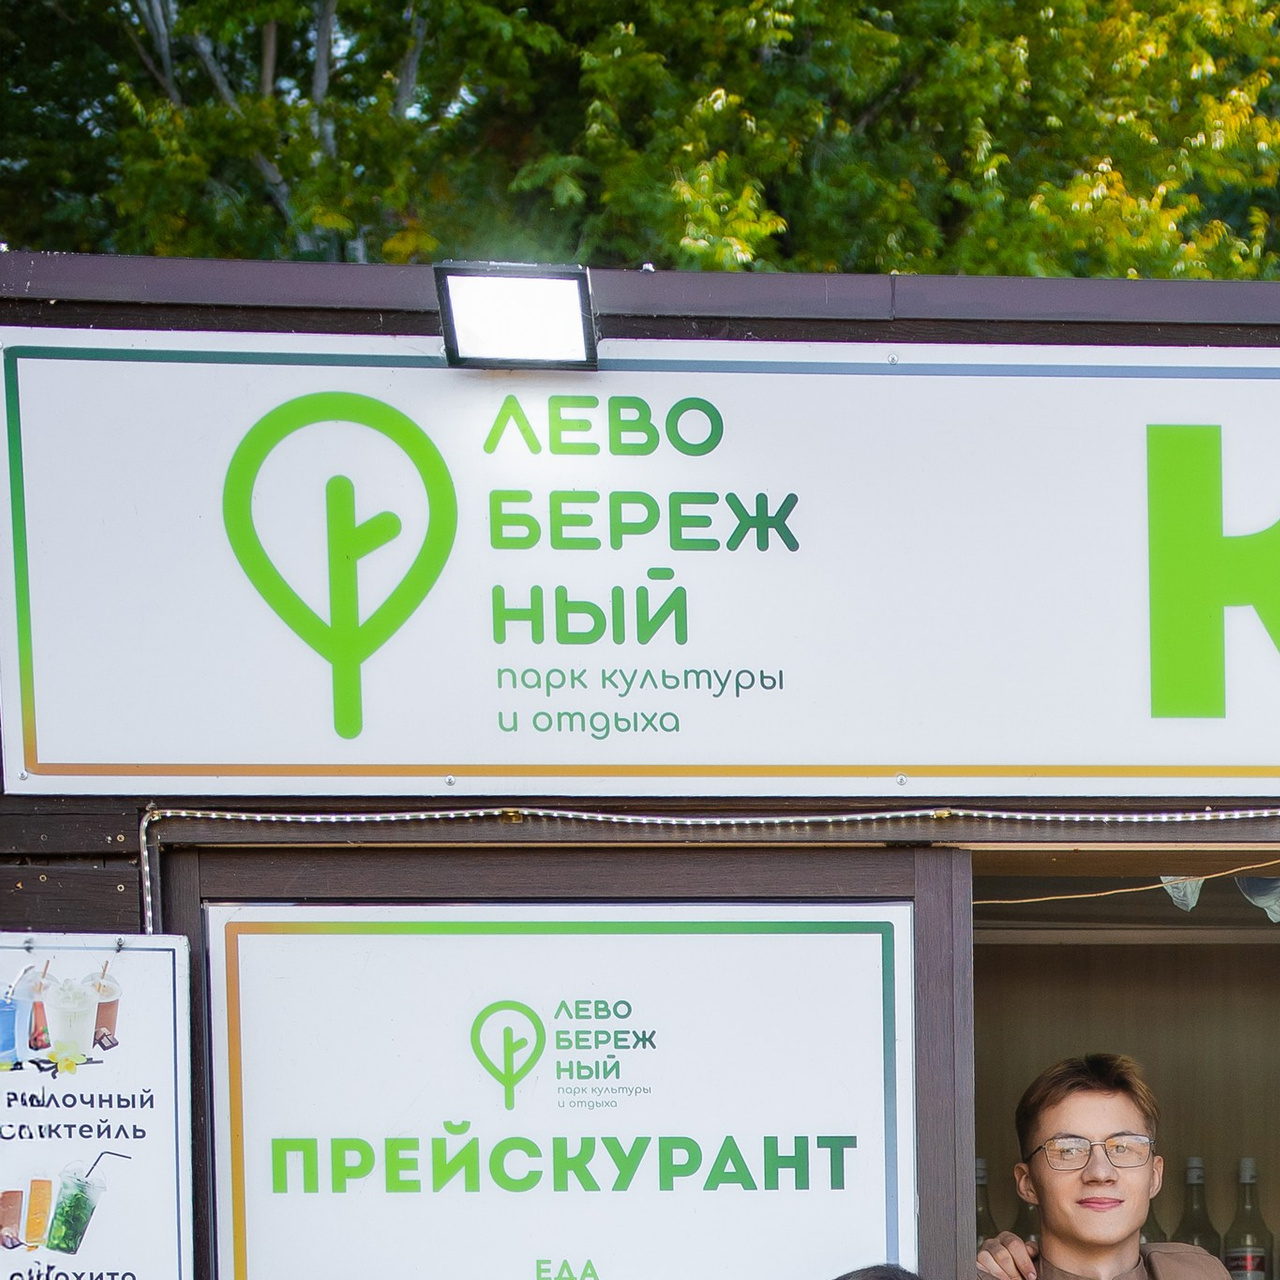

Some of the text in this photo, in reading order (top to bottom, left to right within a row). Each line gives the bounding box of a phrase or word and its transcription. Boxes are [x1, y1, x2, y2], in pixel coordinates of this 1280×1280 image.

[483, 395, 724, 456] ЛЕВО
[489, 490, 799, 552] БЕРЕЖ
[492, 567, 688, 646] НЫЙ
[497, 668, 784, 698] парк культуры
[498, 712, 680, 740] и отдыха
[554, 1000, 633, 1020] ЛЕВО
[556, 1030, 657, 1050] БЕРЕЖ
[556, 1054, 621, 1081] НЫЙ
[557, 1086, 652, 1097] парк культуры
[557, 1100, 618, 1111] и отдыха
[271, 1121, 858, 1193] ПРЕЙСКУРАНТ
